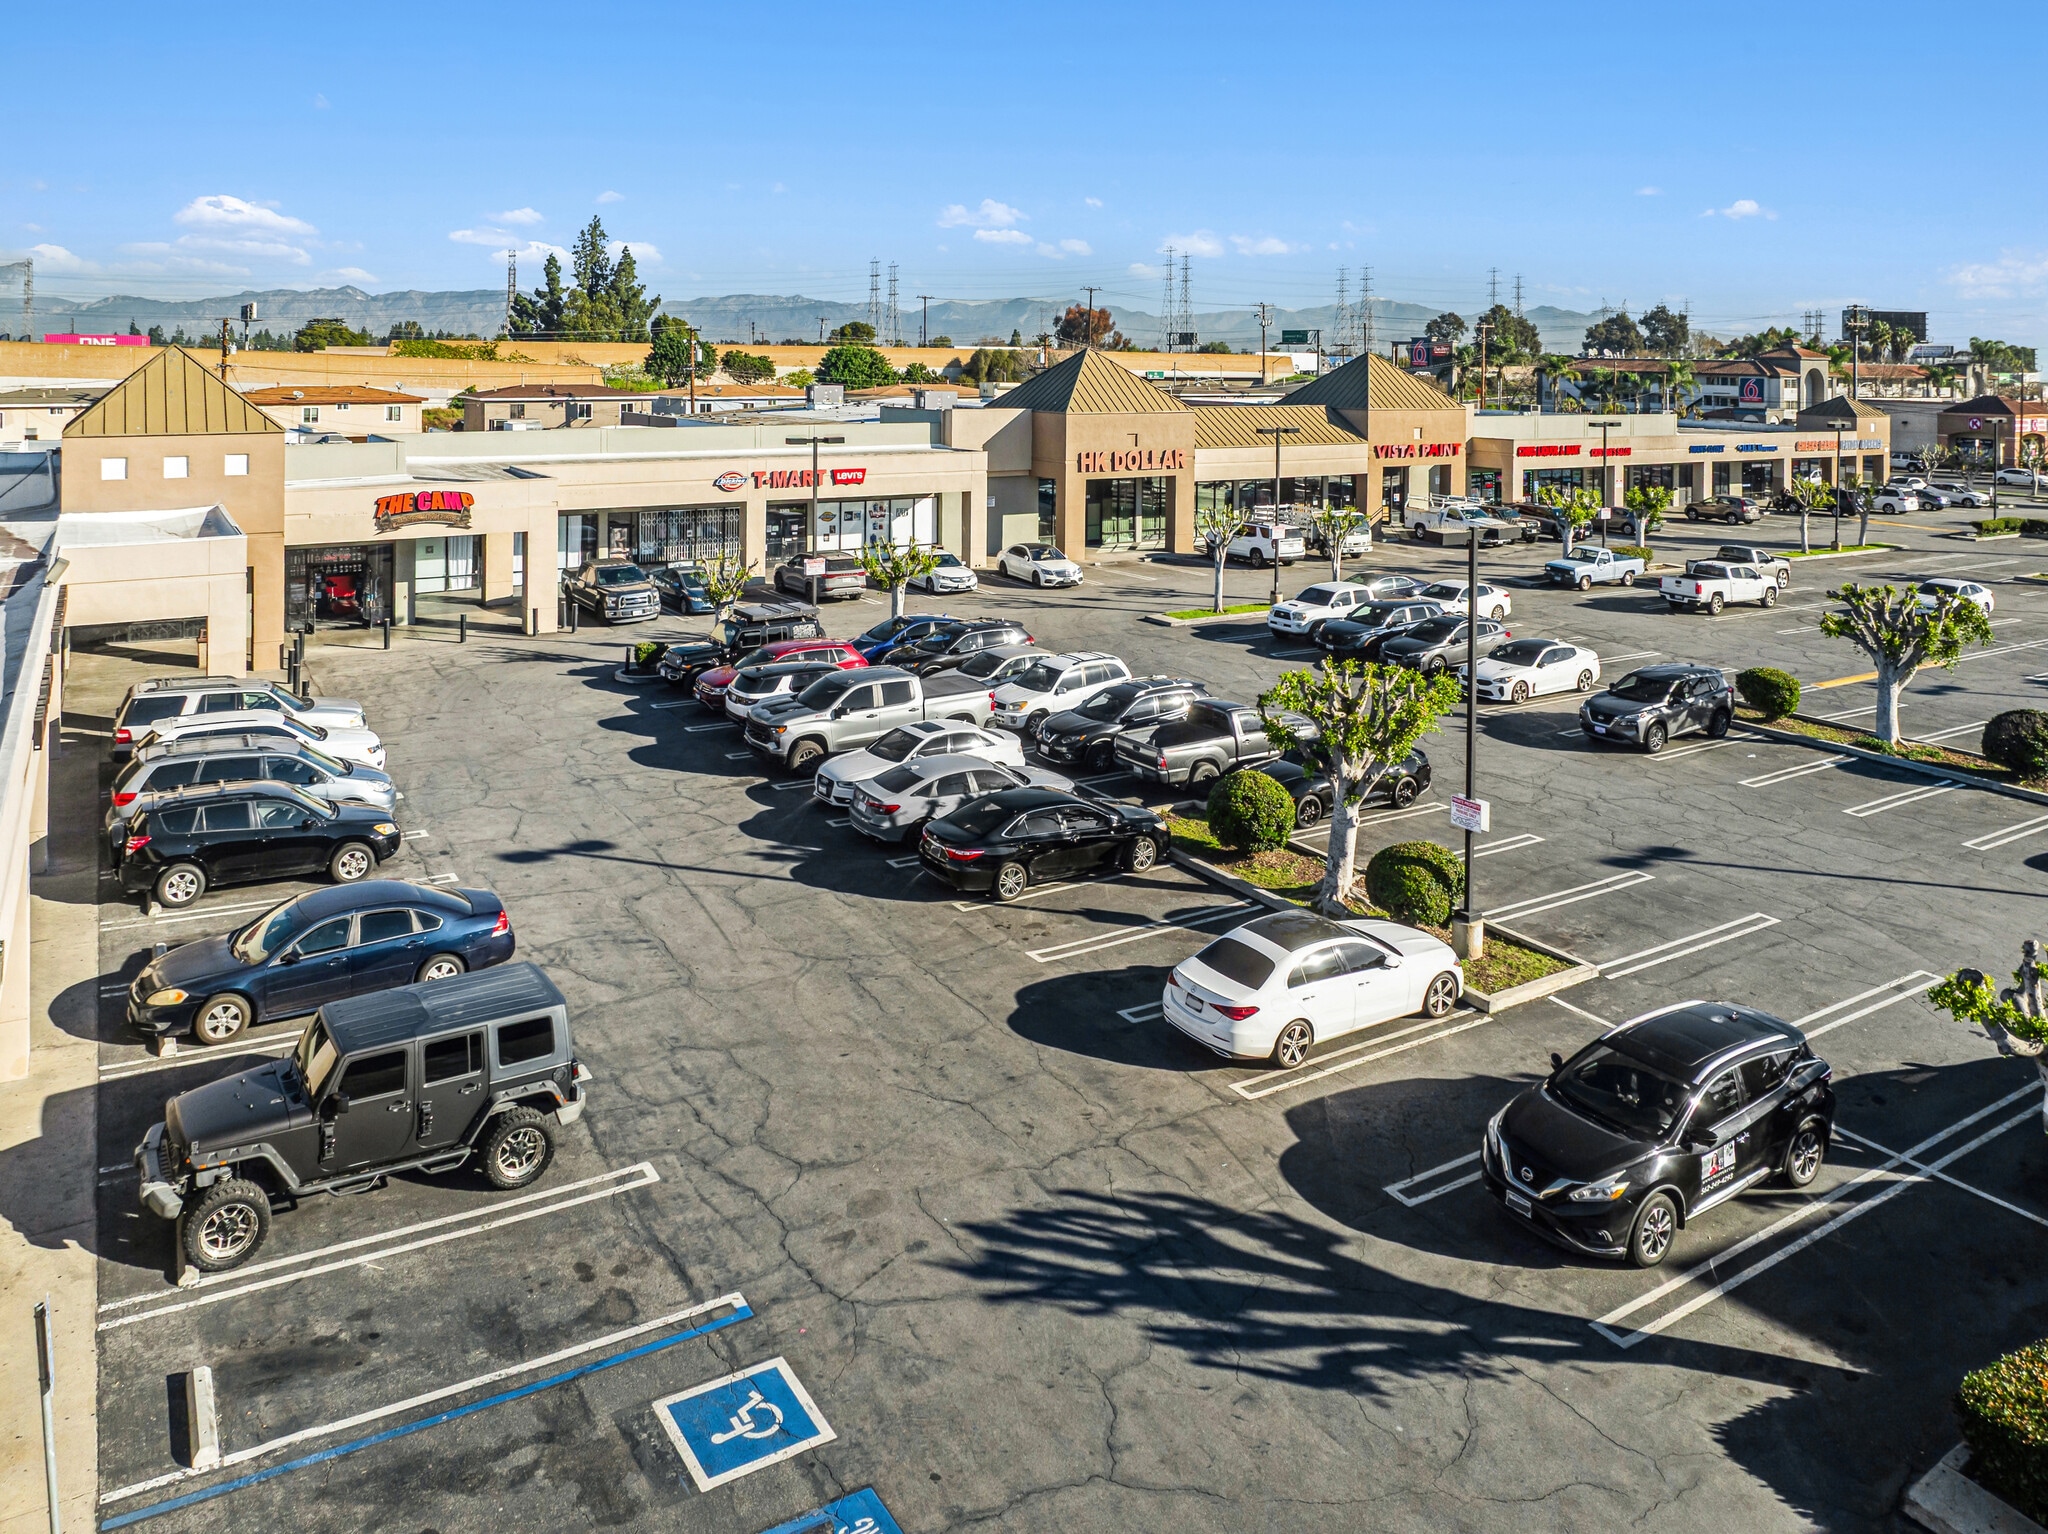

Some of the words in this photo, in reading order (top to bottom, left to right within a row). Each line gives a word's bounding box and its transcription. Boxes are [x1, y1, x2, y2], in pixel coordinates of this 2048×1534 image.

[79, 337, 116, 346] ONE
[1413, 340, 1427, 361] 6
[1743, 378, 1758, 398] 6
[1078, 451, 1108, 473] HK
[1111, 448, 1187, 472] DOLLAR
[1373, 444, 1416, 459] VISTA
[1419, 442, 1462, 457] PAINT
[375, 492, 414, 519] THE
[417, 490, 475, 511] CAMP
